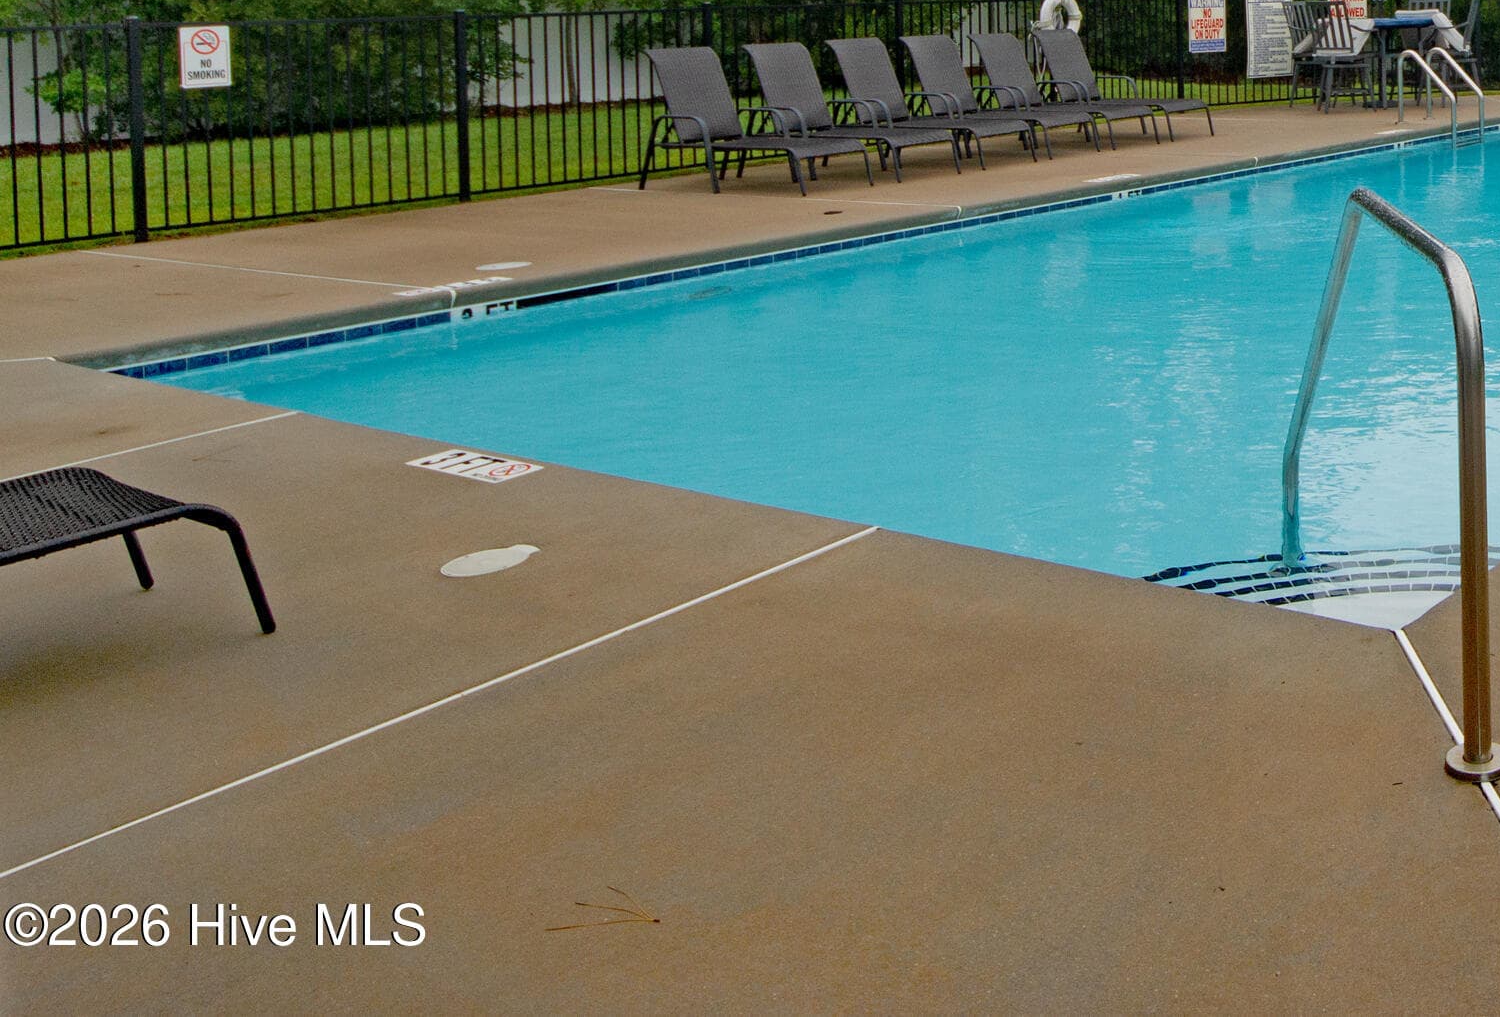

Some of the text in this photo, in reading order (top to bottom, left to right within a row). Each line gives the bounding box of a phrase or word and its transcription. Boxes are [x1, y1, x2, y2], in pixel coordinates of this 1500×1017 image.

[1203, 8, 1211, 18] NO
[1191, 19, 1224, 29] LIFEGUARD
[1195, 29, 1220, 39] ON DUTY
[200, 59, 212, 68] NO
[187, 70, 226, 80] SMOKING
